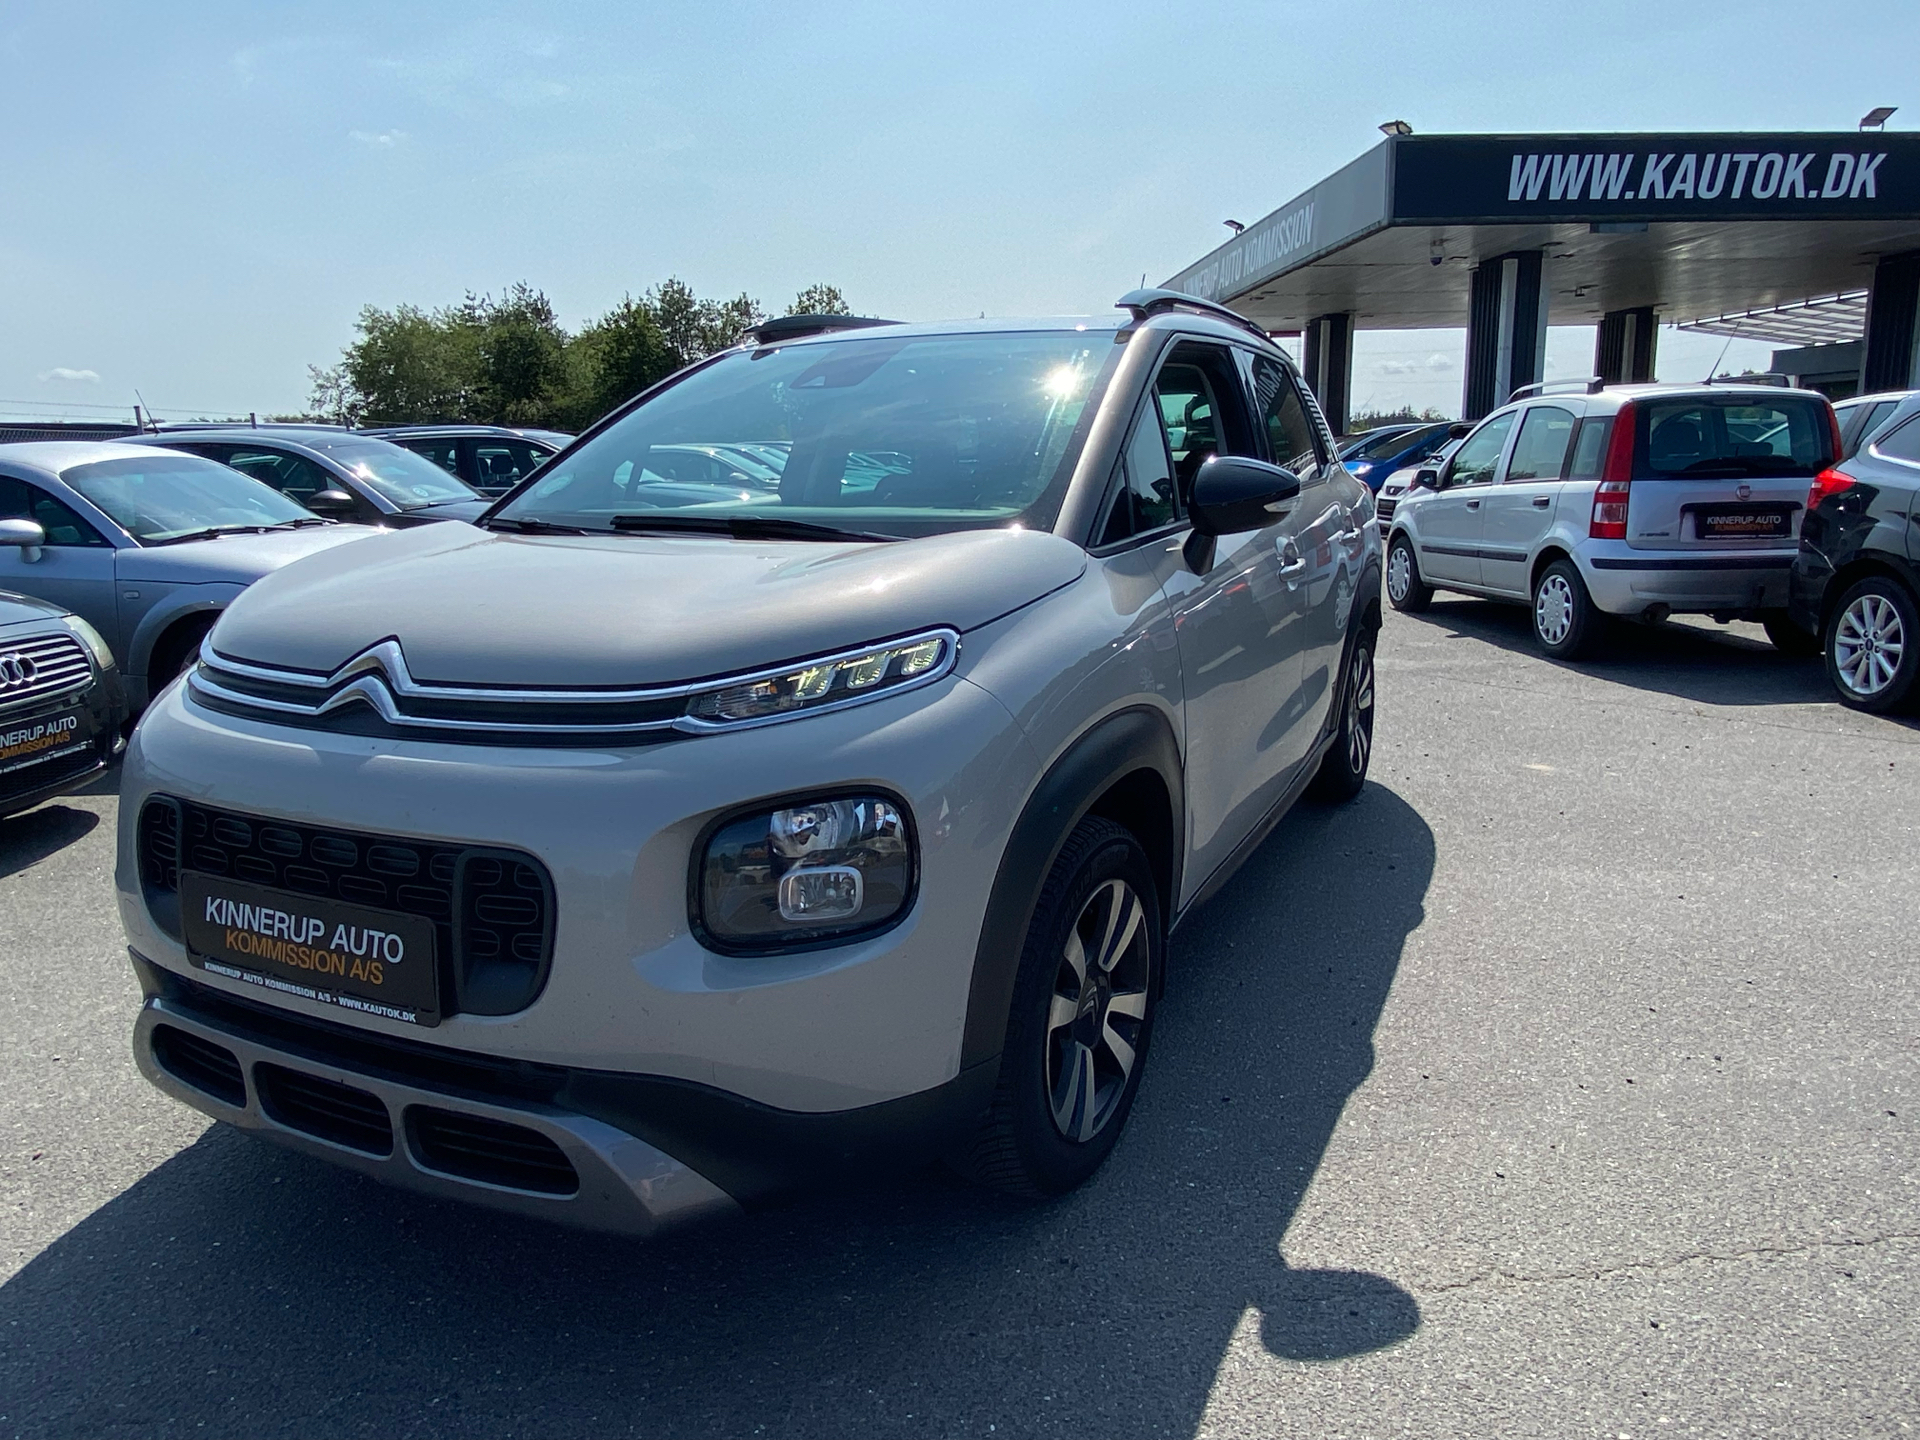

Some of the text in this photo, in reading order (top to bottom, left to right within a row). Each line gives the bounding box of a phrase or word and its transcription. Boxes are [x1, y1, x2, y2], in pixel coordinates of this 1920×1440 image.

[1507, 153, 1888, 201] WWW.KAUTOK.DK
[1218, 247, 1243, 290] AUTO
[1243, 202, 1315, 278] KOMMISSION
[1707, 515, 1782, 525] KINNERUP AUTO
[46, 716, 77, 736] AUTO
[55, 730, 70, 745] A/S
[205, 895, 404, 963] KINNERUP AUTO
[225, 929, 384, 984] KOMMISSION A/S
[204, 961, 416, 1023] KINNERUP AUTO KOMMISSION A/S WWW.KAUTOK.DK
